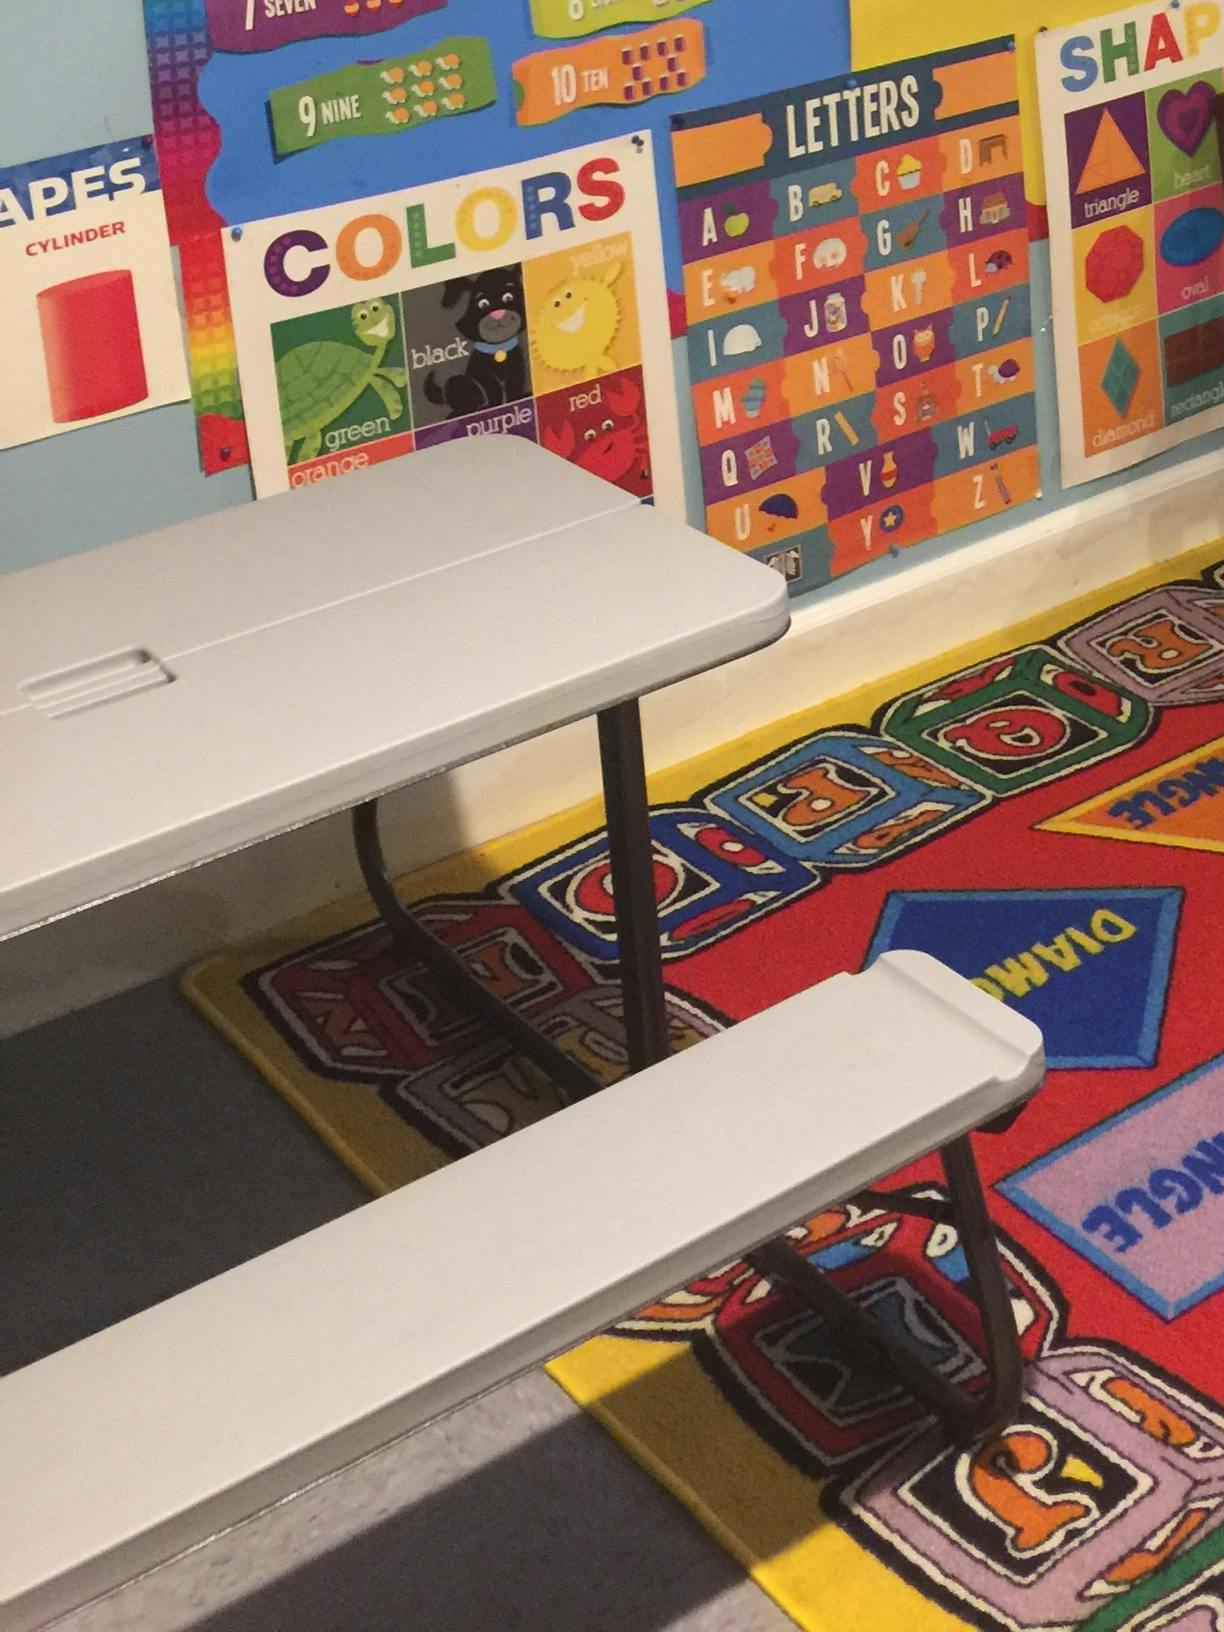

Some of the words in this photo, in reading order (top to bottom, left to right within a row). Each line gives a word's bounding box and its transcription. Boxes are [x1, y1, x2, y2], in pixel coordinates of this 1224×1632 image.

[551, 65, 576, 104] 10
[582, 68, 609, 93] TEN
[298, 96, 317, 137] 9
[322, 95, 361, 125] NINE
[786, 75, 920, 158] LETTERS
[702, 207, 718, 246] A
[787, 185, 803, 221] B
[875, 160, 890, 197] C
[959, 138, 973, 175] D
[1173, 164, 1209, 189] heart
[1084, 187, 1139, 219] triangle
[25, 220, 126, 256] CYLINDER
[263, 157, 626, 297] COLORS
[569, 240, 630, 275] yellow
[701, 268, 715, 307] E
[795, 244, 806, 280] F
[877, 219, 891, 256] G
[958, 197, 973, 233] H
[1181, 277, 1209, 300] oval
[707, 329, 717, 367] I
[804, 300, 817, 338] J
[890, 275, 907, 313] K
[968, 252, 981, 288] L
[411, 338, 469, 370] black
[712, 387, 736, 429] M
[811, 358, 830, 396] N
[893, 334, 907, 370] O
[975, 307, 989, 342] P
[569, 385, 601, 412] red
[324, 416, 390, 451] green
[465, 405, 532, 437] purple
[721, 449, 738, 487] Q
[816, 418, 832, 456] R
[894, 391, 906, 426] S
[972, 363, 983, 398] T
[1092, 413, 1155, 448] diamond
[290, 451, 369, 488] orange
[735, 504, 751, 541] U
[859, 460, 872, 496] V
[957, 421, 975, 460] W
[860, 515, 873, 551] Y
[972, 474, 986, 510] Z
